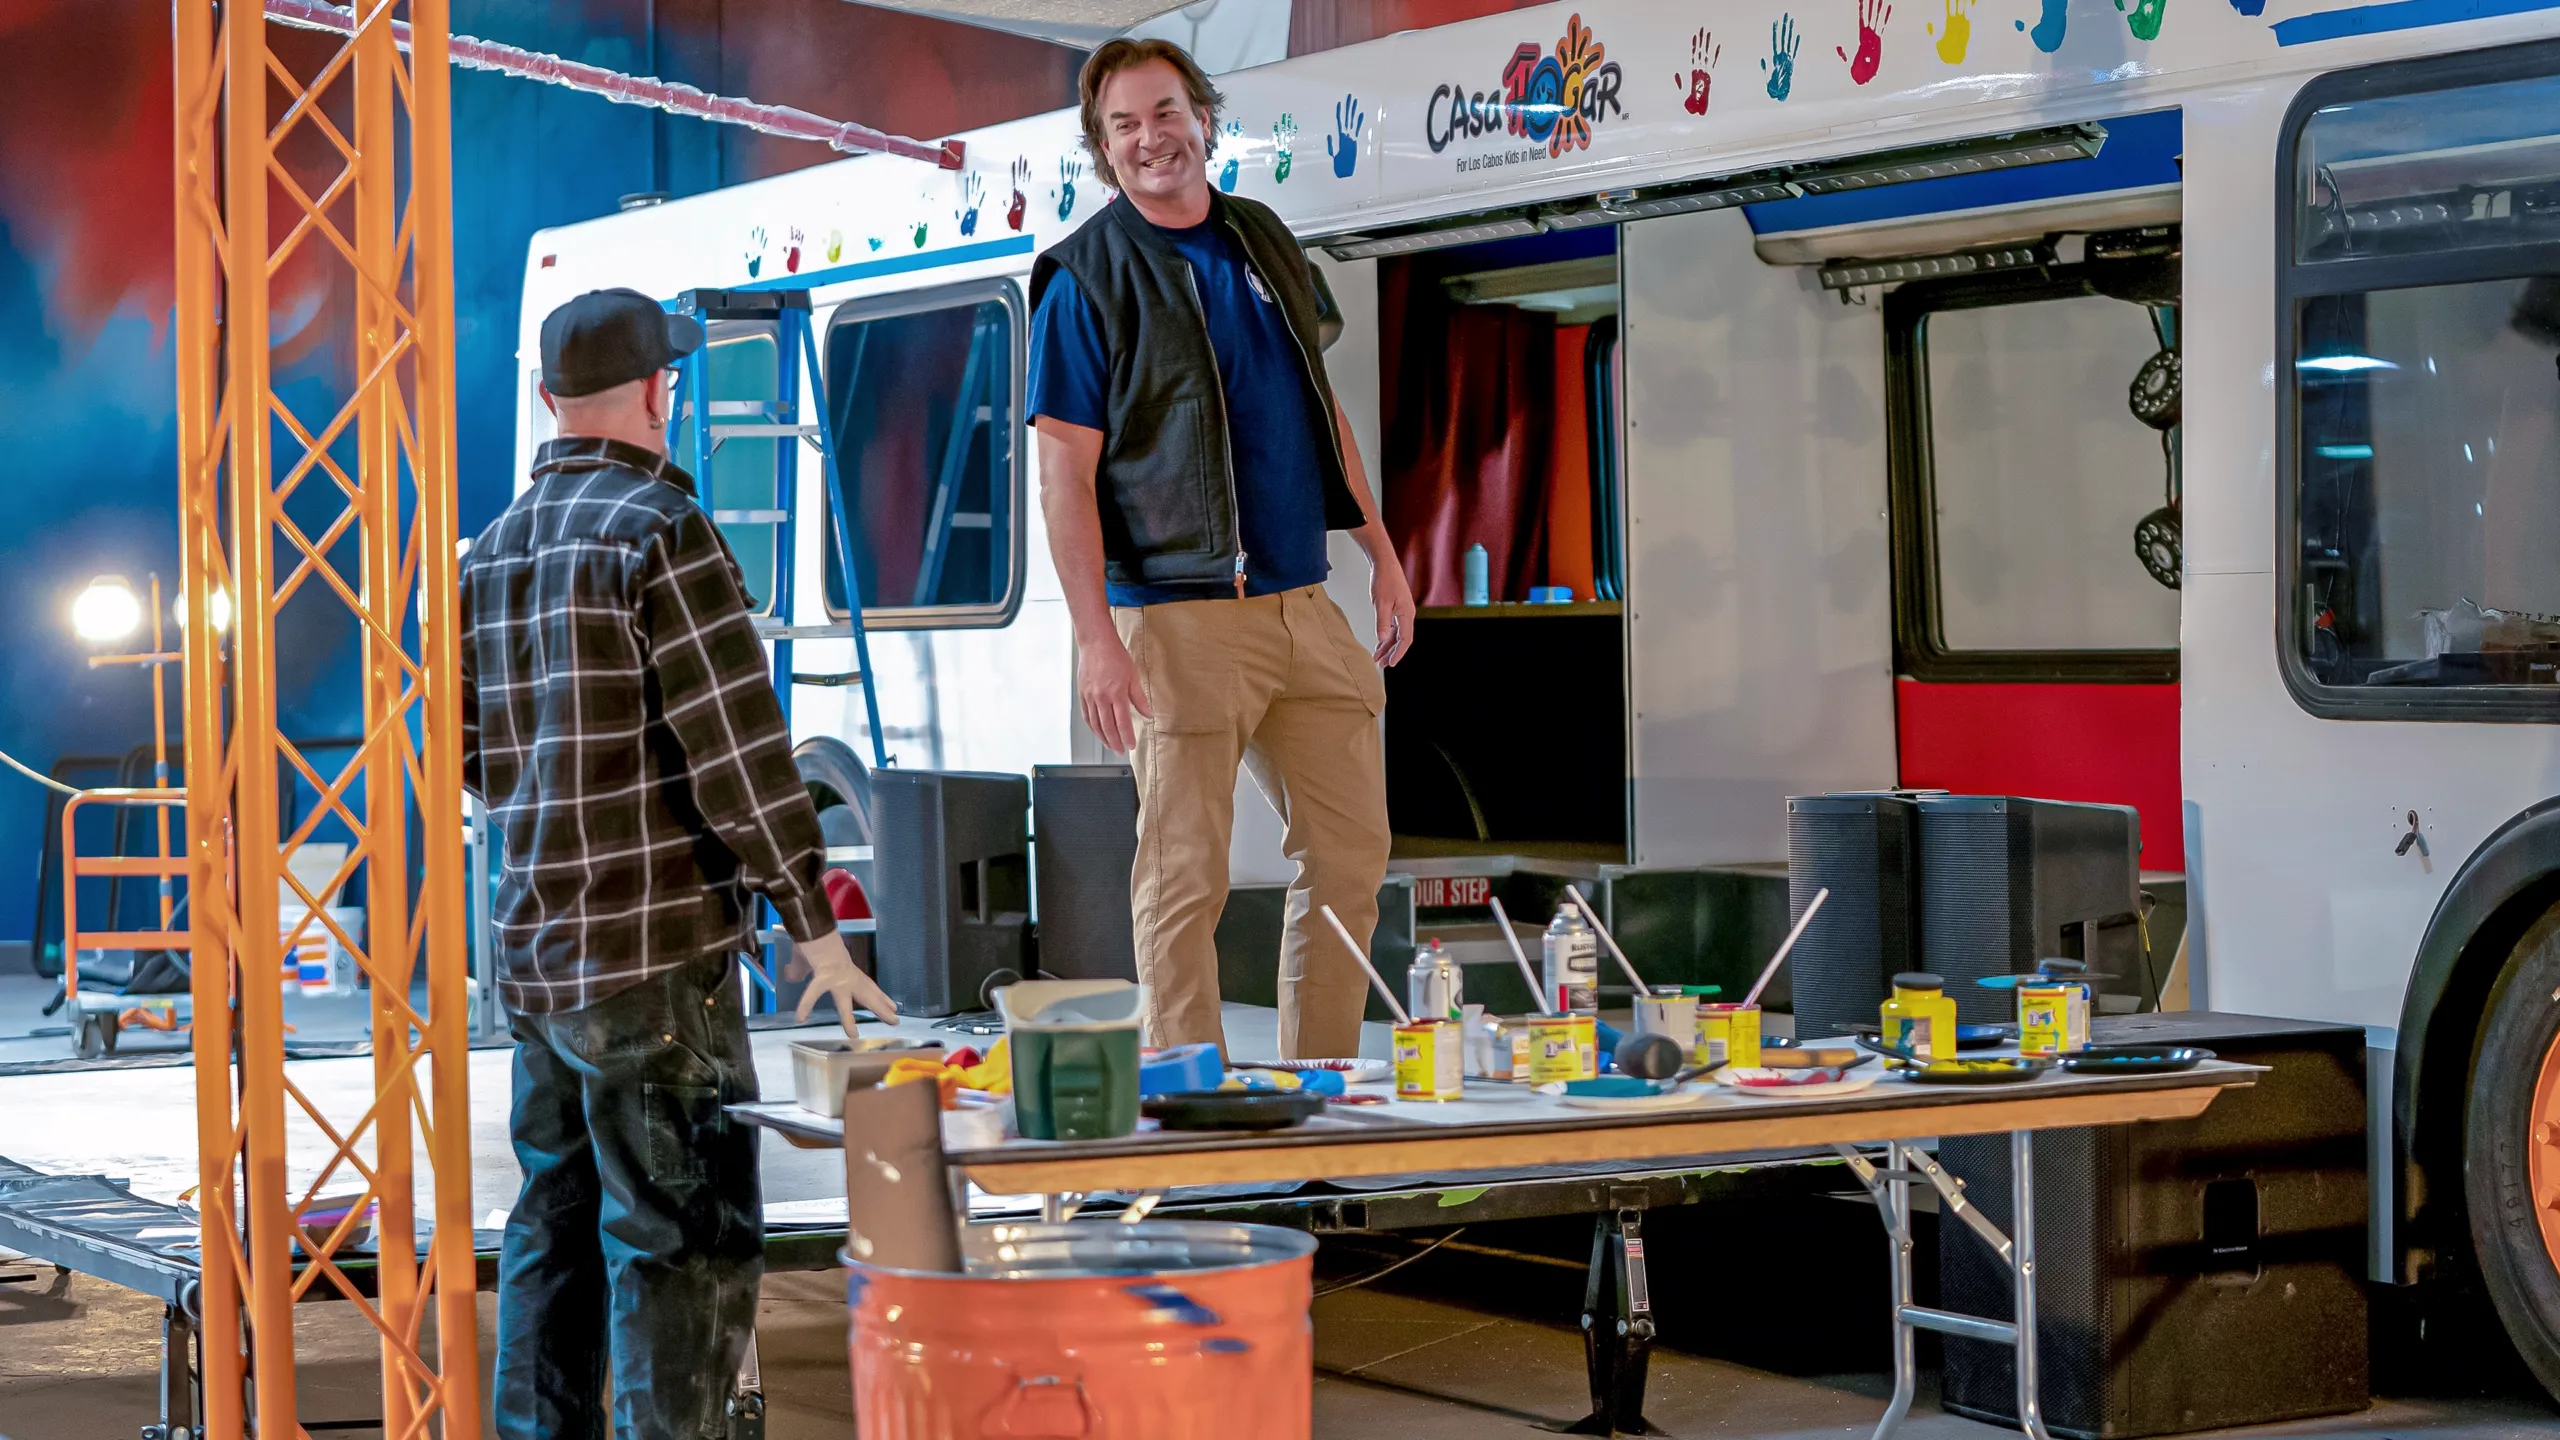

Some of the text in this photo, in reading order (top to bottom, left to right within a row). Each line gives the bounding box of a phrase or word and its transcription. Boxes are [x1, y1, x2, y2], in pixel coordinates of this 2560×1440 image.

[1456, 144, 1547, 173] For Los Cabos Kids in Need
[1450, 877, 1488, 905] STEP
